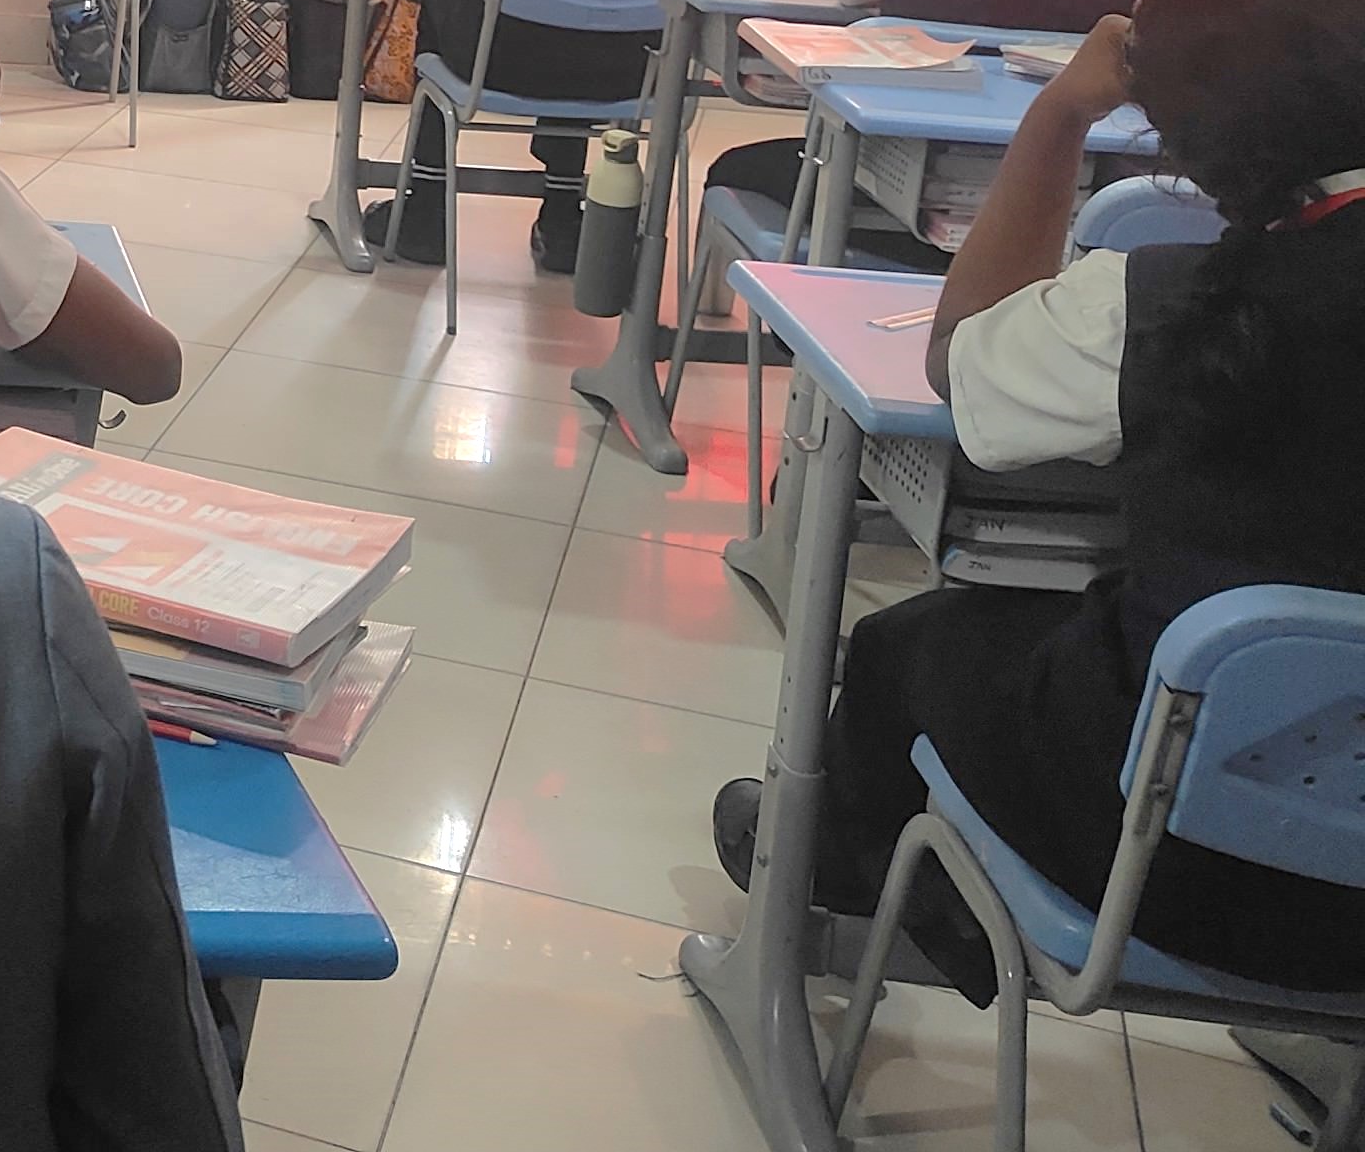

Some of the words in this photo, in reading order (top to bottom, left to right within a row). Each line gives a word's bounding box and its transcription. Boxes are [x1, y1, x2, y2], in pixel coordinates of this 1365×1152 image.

[84, 478, 189, 514] CORE
[99, 590, 139, 617] CORE
[146, 606, 190, 629] Class
[194, 618, 211, 634] 12
